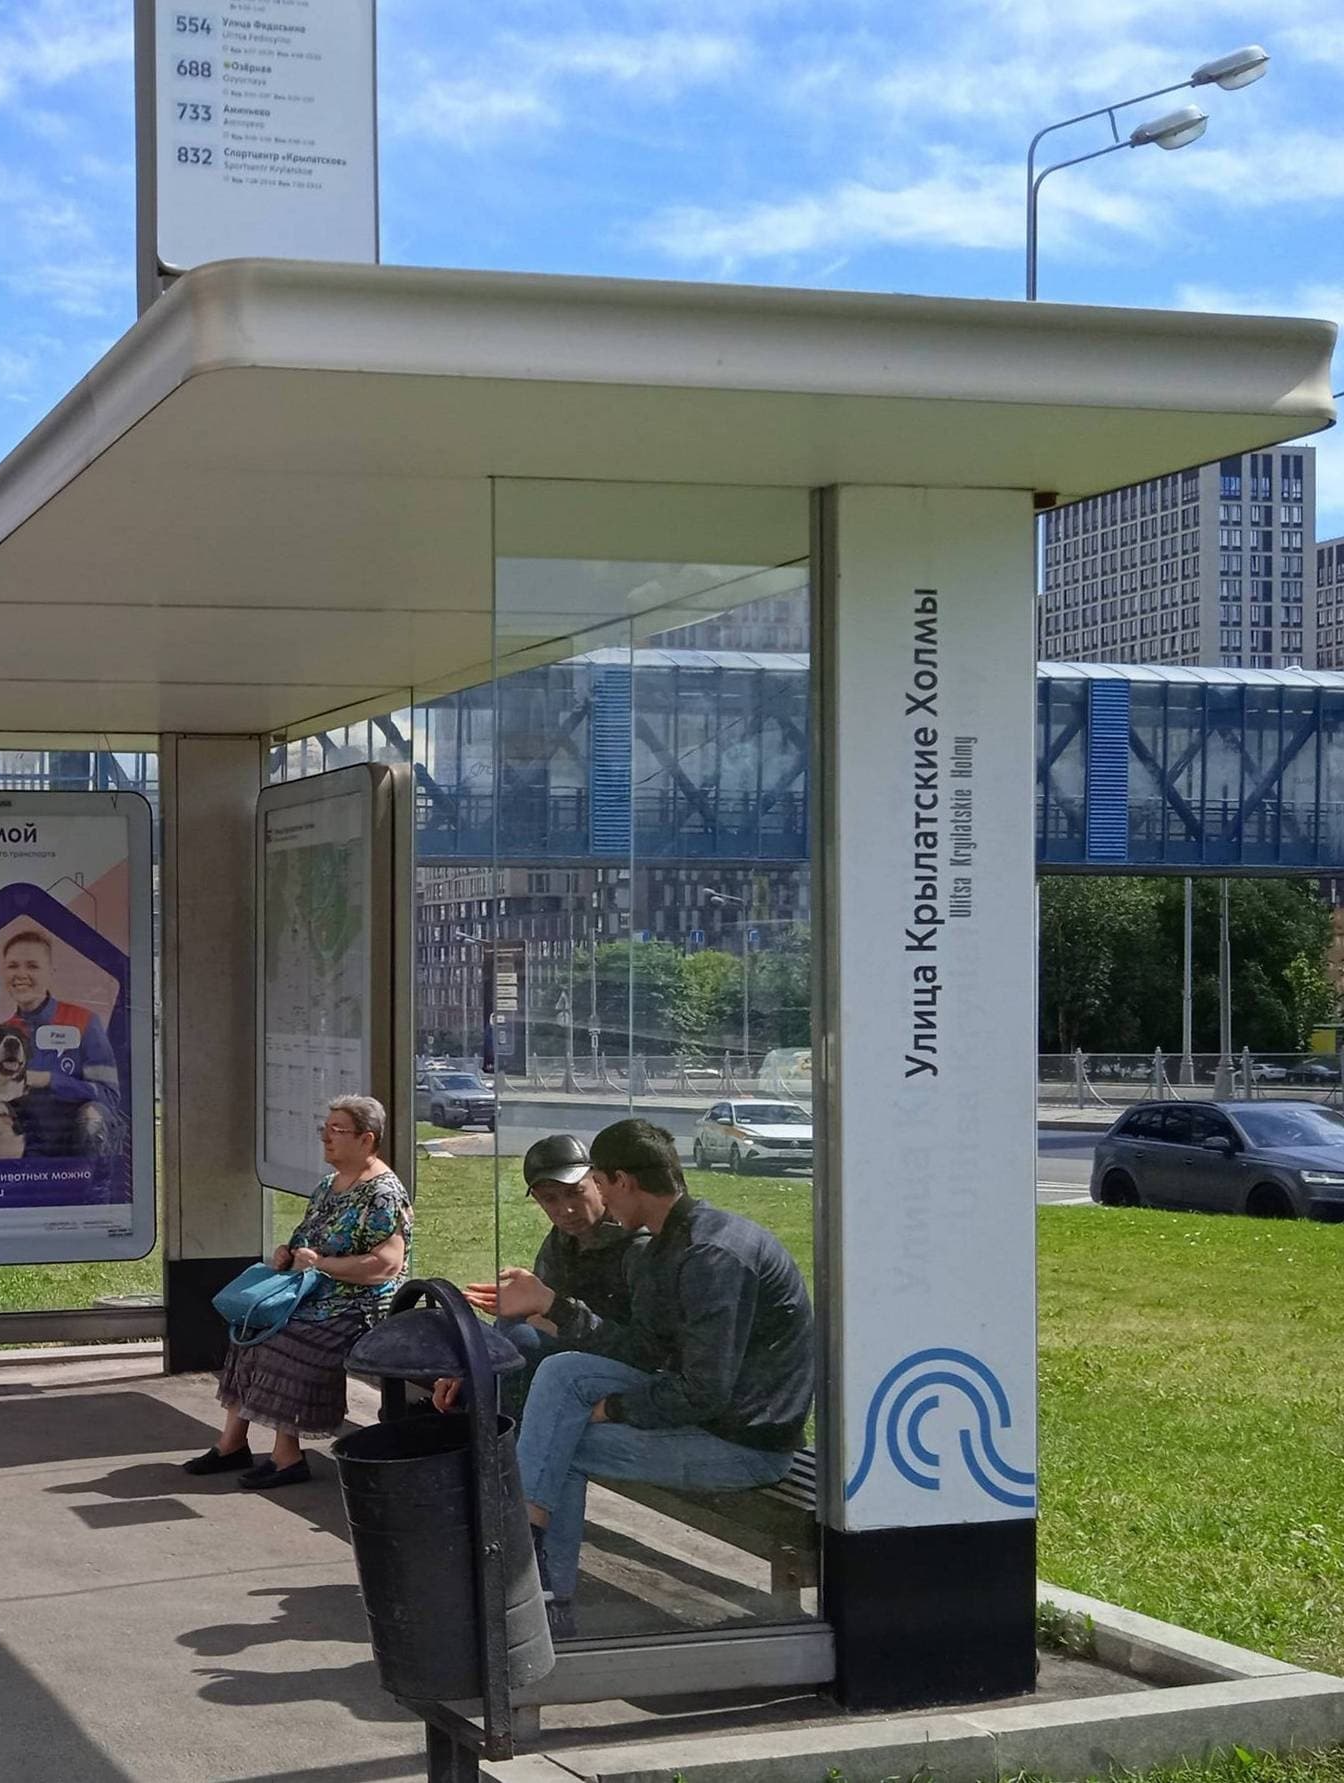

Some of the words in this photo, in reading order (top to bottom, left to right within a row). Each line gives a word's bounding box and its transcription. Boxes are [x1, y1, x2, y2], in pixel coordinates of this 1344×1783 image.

[176, 15, 212, 35] 554
[176, 59, 212, 78] 688
[177, 103, 212, 122] 733
[177, 147, 213, 166] 832
[223, 147, 280, 162] Спортцентр
[905, 588, 938, 718] Холмы
[950, 736, 977, 779] Holmy
[949, 789, 977, 866] Kryilatskie
[905, 727, 945, 952] Крылатские
[8, 850, 57, 859] транспорта
[949, 878, 972, 918] Ulitsa
[905, 965, 943, 1078] Улица
[51, 1170, 92, 1181] можно
